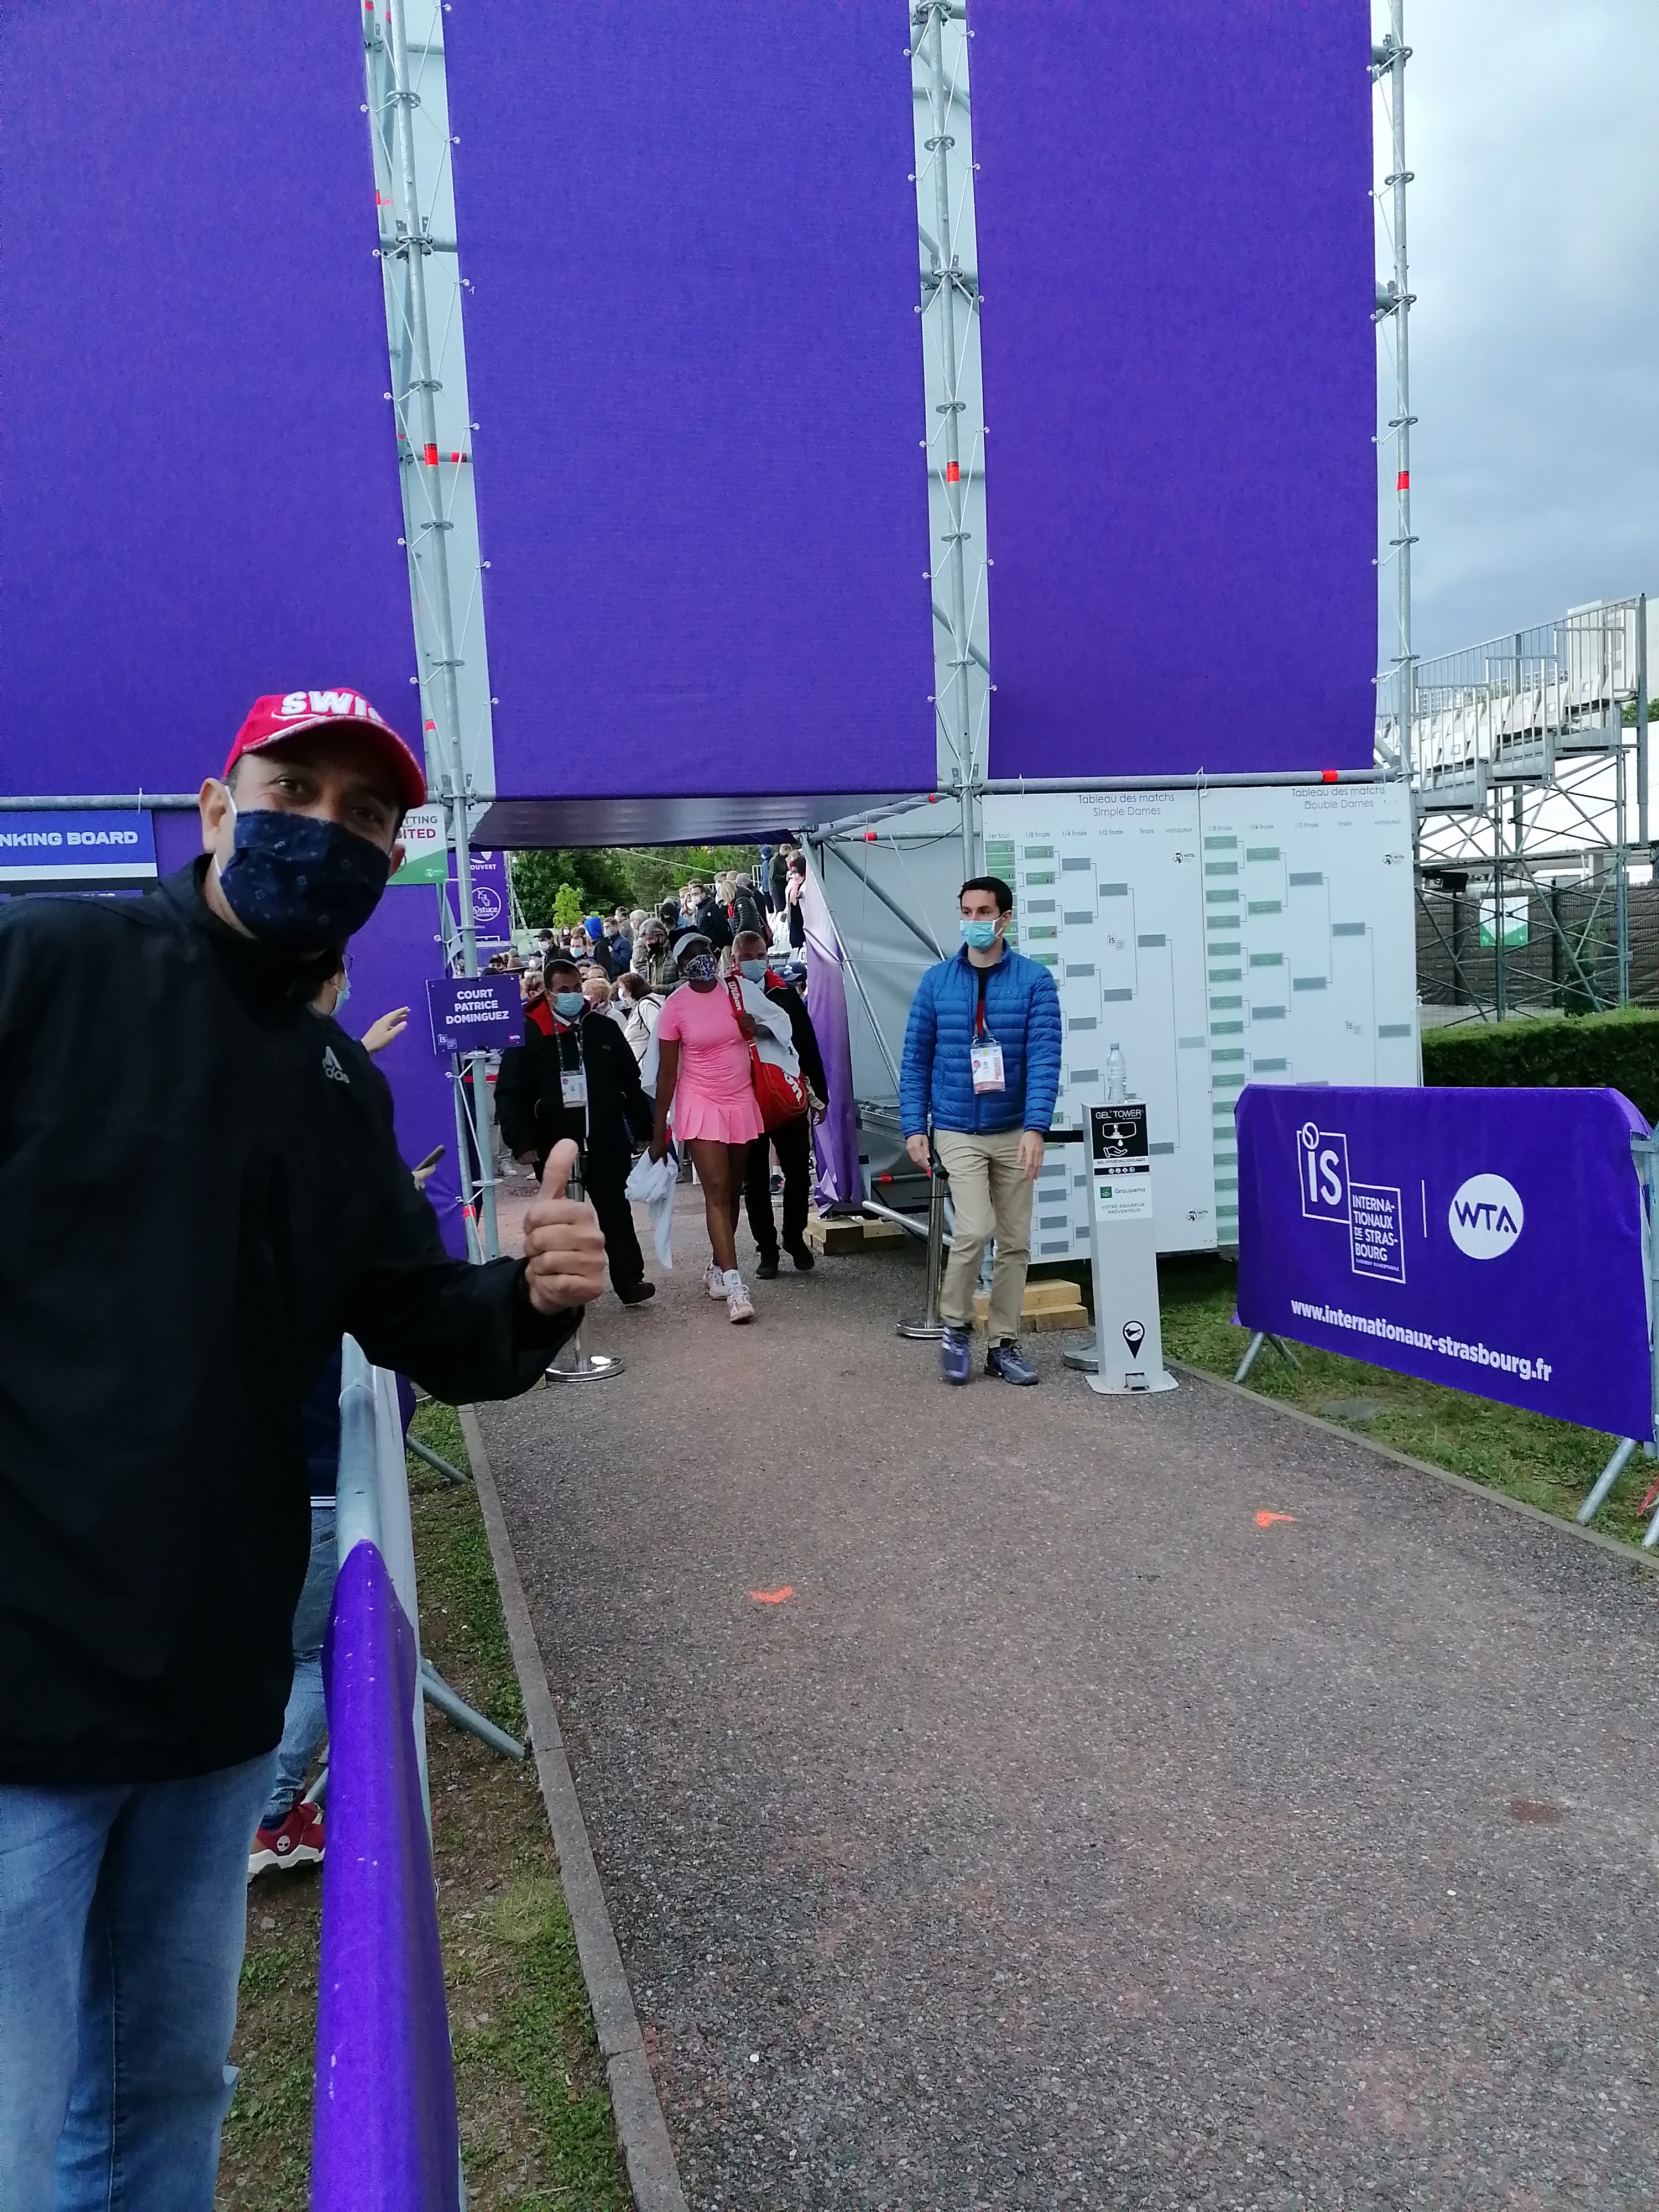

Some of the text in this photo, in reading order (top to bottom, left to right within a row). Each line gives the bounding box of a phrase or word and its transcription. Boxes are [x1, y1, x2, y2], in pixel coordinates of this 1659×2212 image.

[1078, 793, 1175, 804] Tableau des matchs
[1292, 786, 1385, 797] Tableau des matchs
[1093, 806, 1161, 817] Simple Dames
[1305, 799, 1374, 809] Double Dames
[66, 831, 138, 846] BOARD
[456, 989, 494, 1000] COURT
[727, 980, 742, 1011] Wilson
[454, 1000, 499, 1012] PATRICE
[446, 1010, 510, 1025] DOMINGUEZ
[1352, 1194, 1396, 1213] INTERNA-
[1353, 1210, 1394, 1229] TIONAUX
[1454, 1200, 1518, 1234] WTA
[1354, 1226, 1399, 1246] DE STRAS-
[1355, 1242, 1388, 1261] BOURG
[1291, 1300, 1552, 1382] www.internationaux-strasbourg.fr
